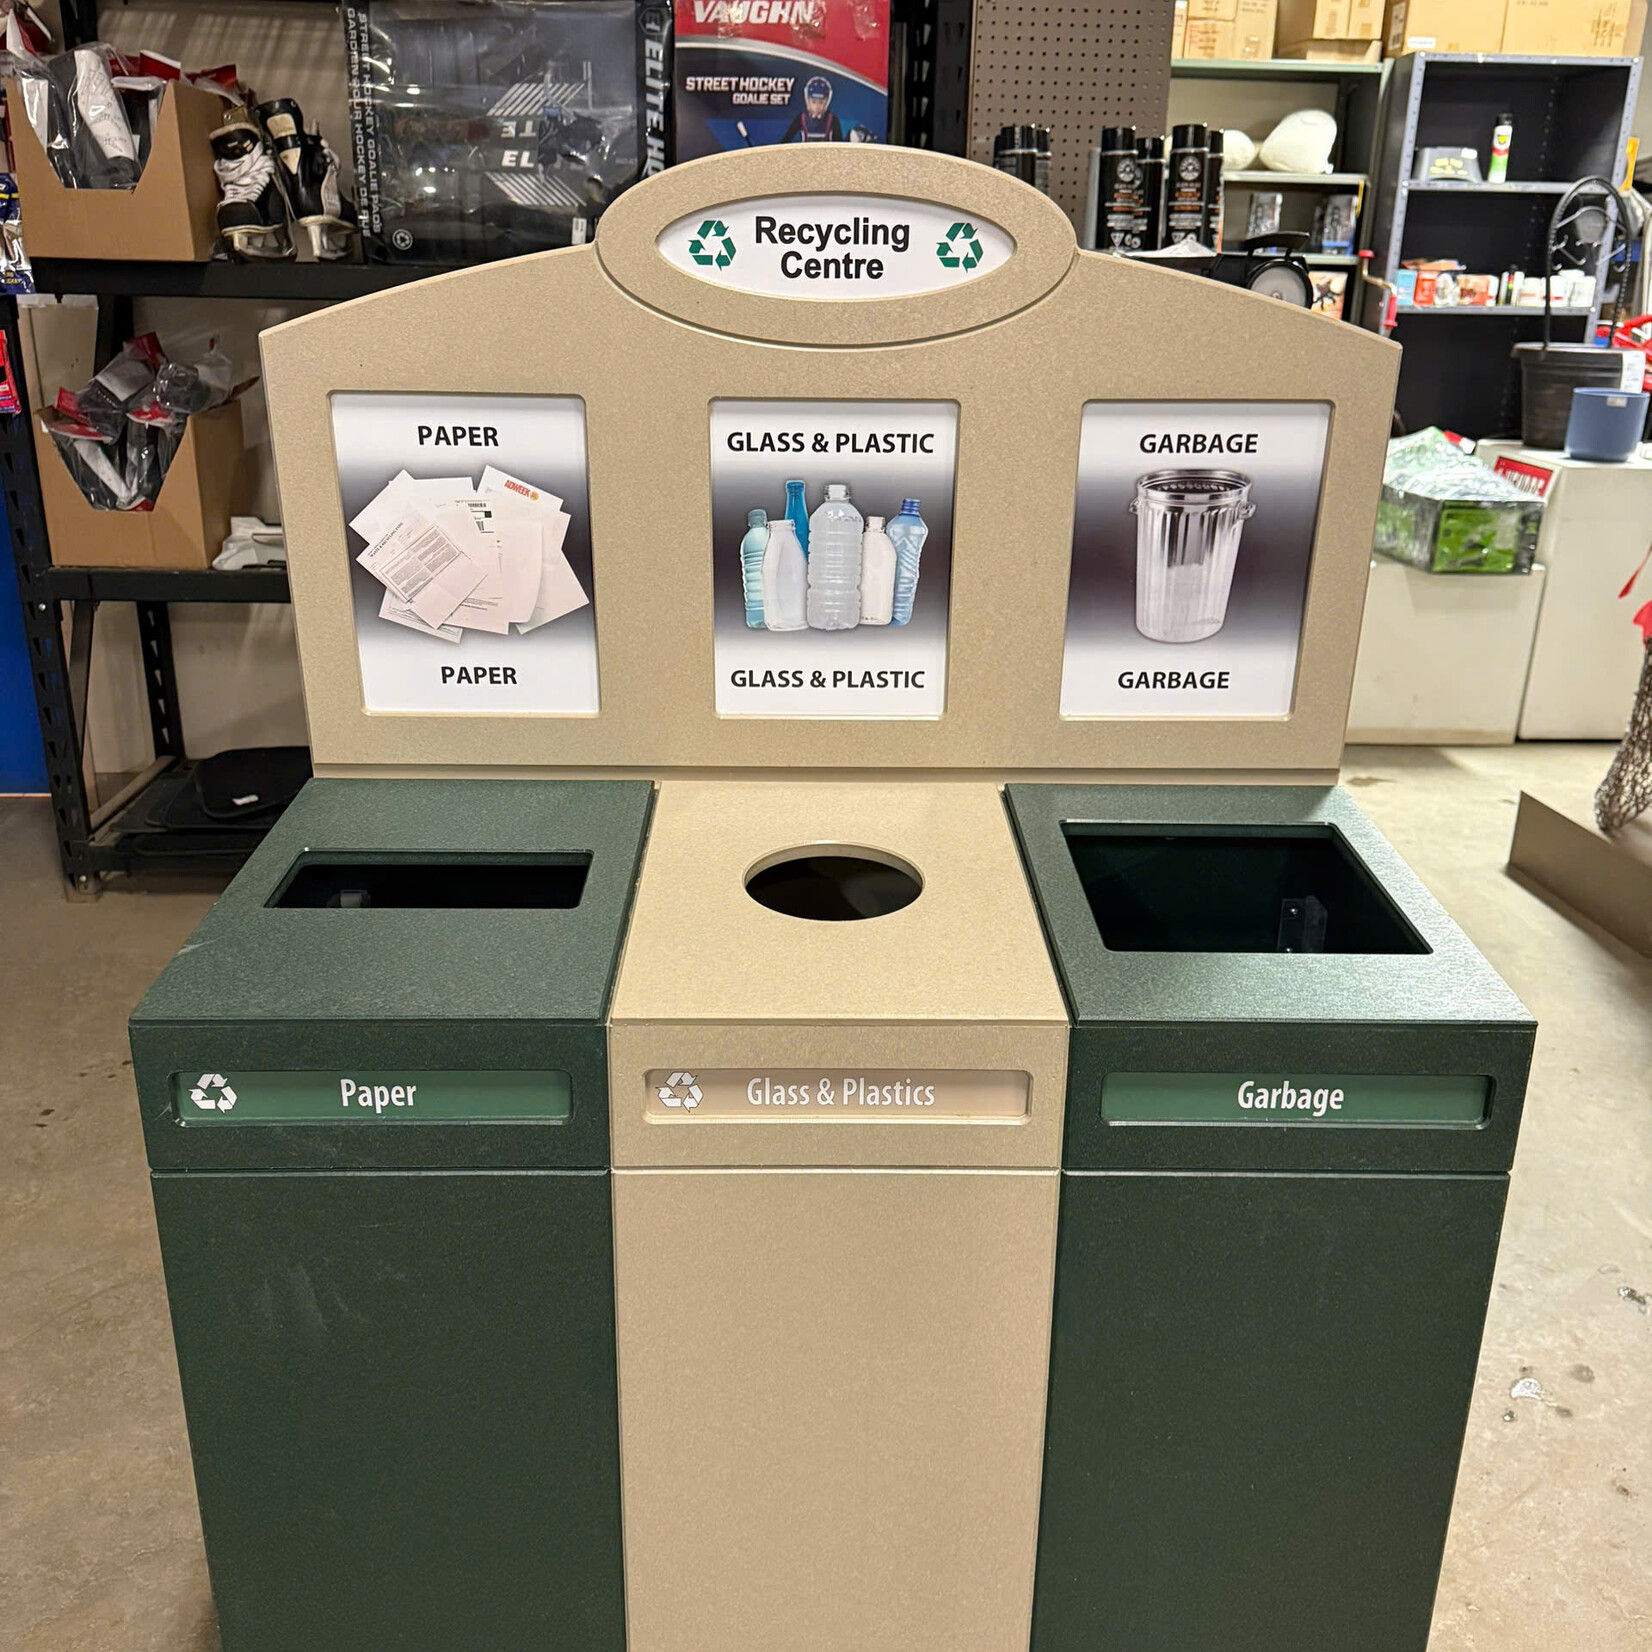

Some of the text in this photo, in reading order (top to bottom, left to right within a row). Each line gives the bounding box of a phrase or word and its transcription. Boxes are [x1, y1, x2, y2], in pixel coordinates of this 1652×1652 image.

[694, 0, 814, 24] VAUGHN
[347, 8, 359, 76] GARDIEN
[358, 12, 370, 71] STREET
[645, 38, 664, 132] ELITE
[685, 76, 795, 92] STREET HOCKEY
[363, 74, 374, 135] HOCKEY
[732, 93, 790, 105] GOALIE SET
[355, 123, 366, 183] HOCKEY
[367, 138, 378, 191] GOALIE
[360, 187, 368, 207] DE
[361, 209, 371, 237] RUE
[756, 216, 909, 253] Recycling
[781, 250, 883, 280] Centre
[418, 426, 498, 446] PAPER
[728, 432, 934, 453] GLASS & PLASTIC
[1140, 434, 1258, 453] GARBAGE
[441, 667, 517, 684] PAPER
[731, 670, 925, 688] GLASS & PLASTIC
[1118, 672, 1229, 689] GARBAGE
[341, 1079, 417, 1113] Paper
[746, 1077, 936, 1107] Glass & Plastics
[1238, 1080, 1344, 1117] Garbage
